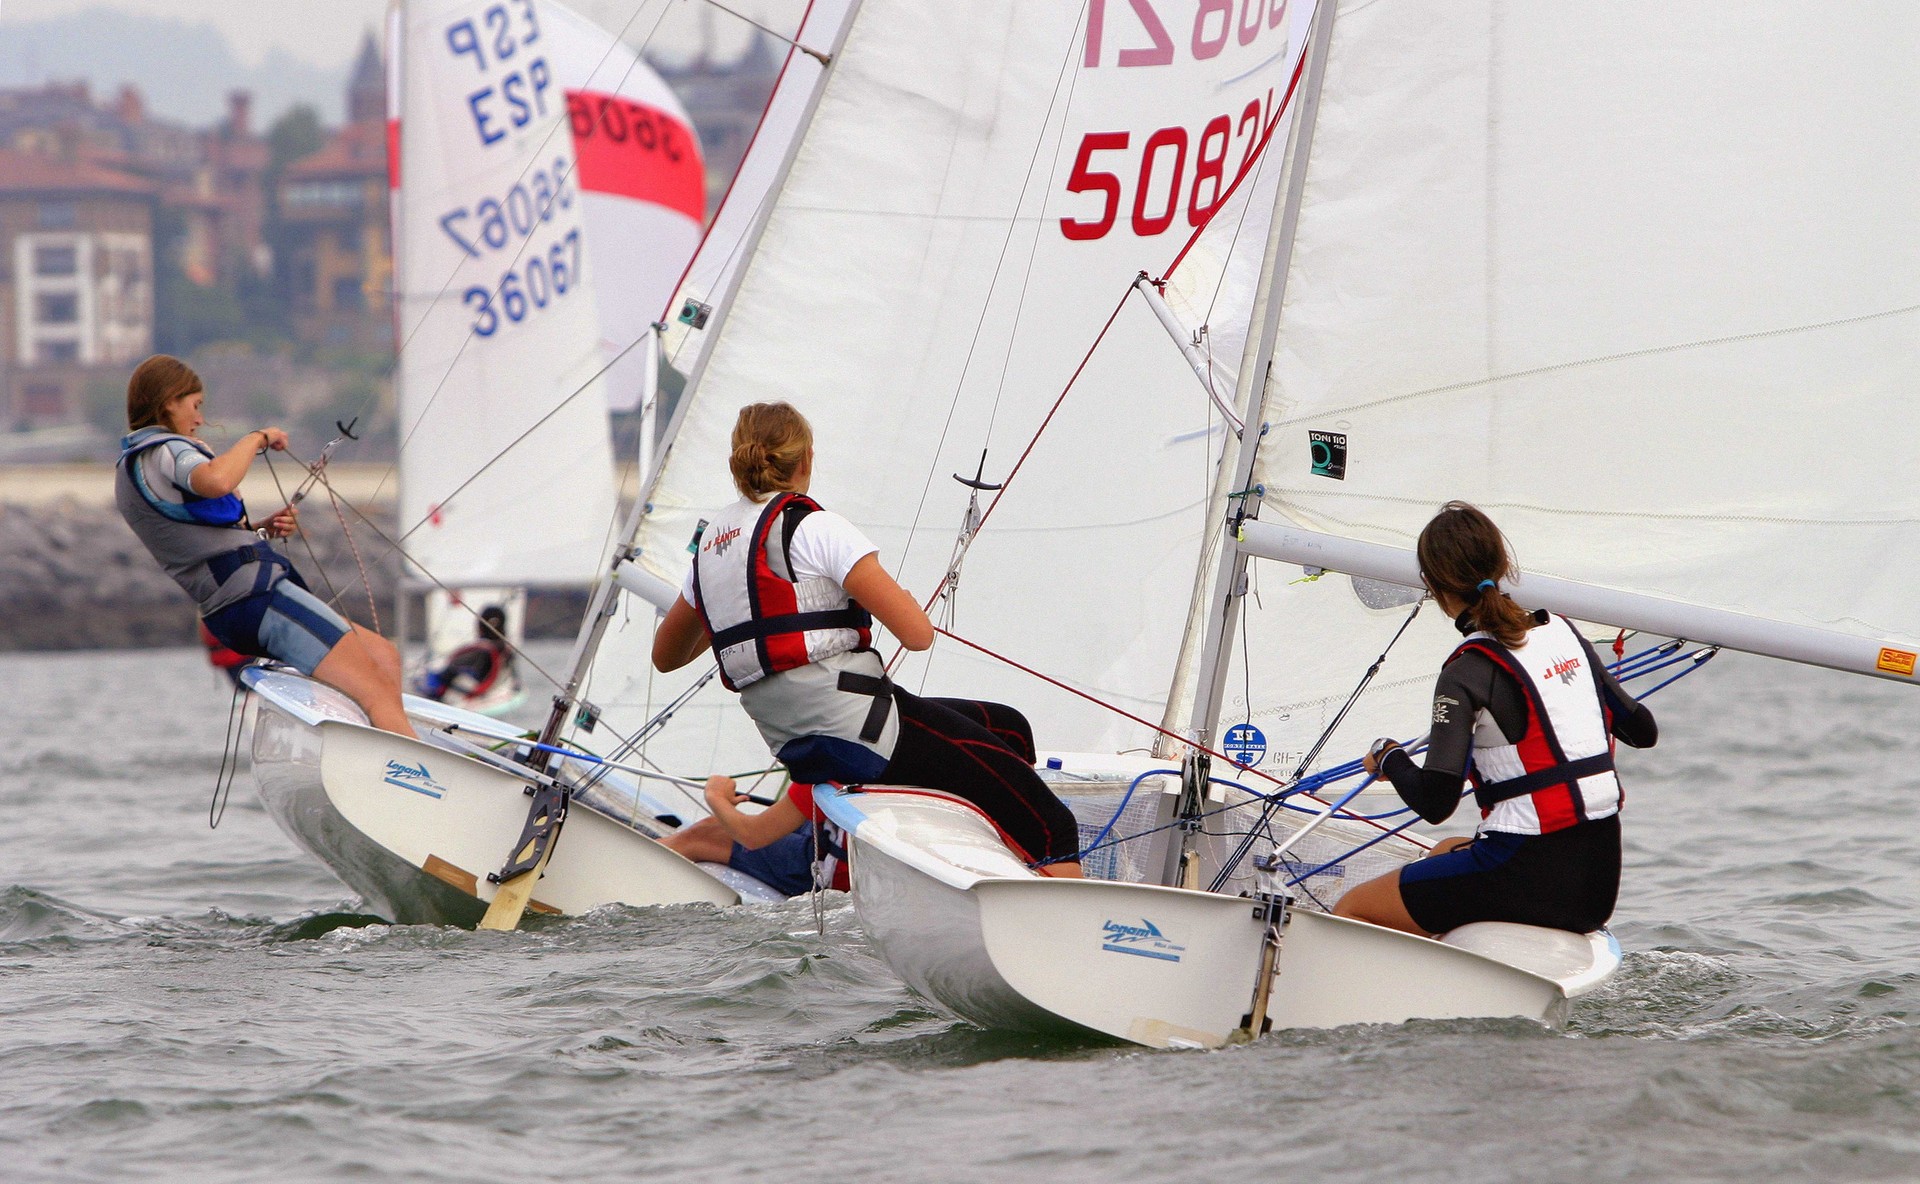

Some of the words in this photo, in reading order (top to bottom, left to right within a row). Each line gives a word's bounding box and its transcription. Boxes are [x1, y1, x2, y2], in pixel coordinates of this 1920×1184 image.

[465, 56, 551, 147] ESP
[462, 226, 582, 338] 36067
[1310, 433, 1331, 442] TONI
[1332, 436, 1346, 445] TIO
